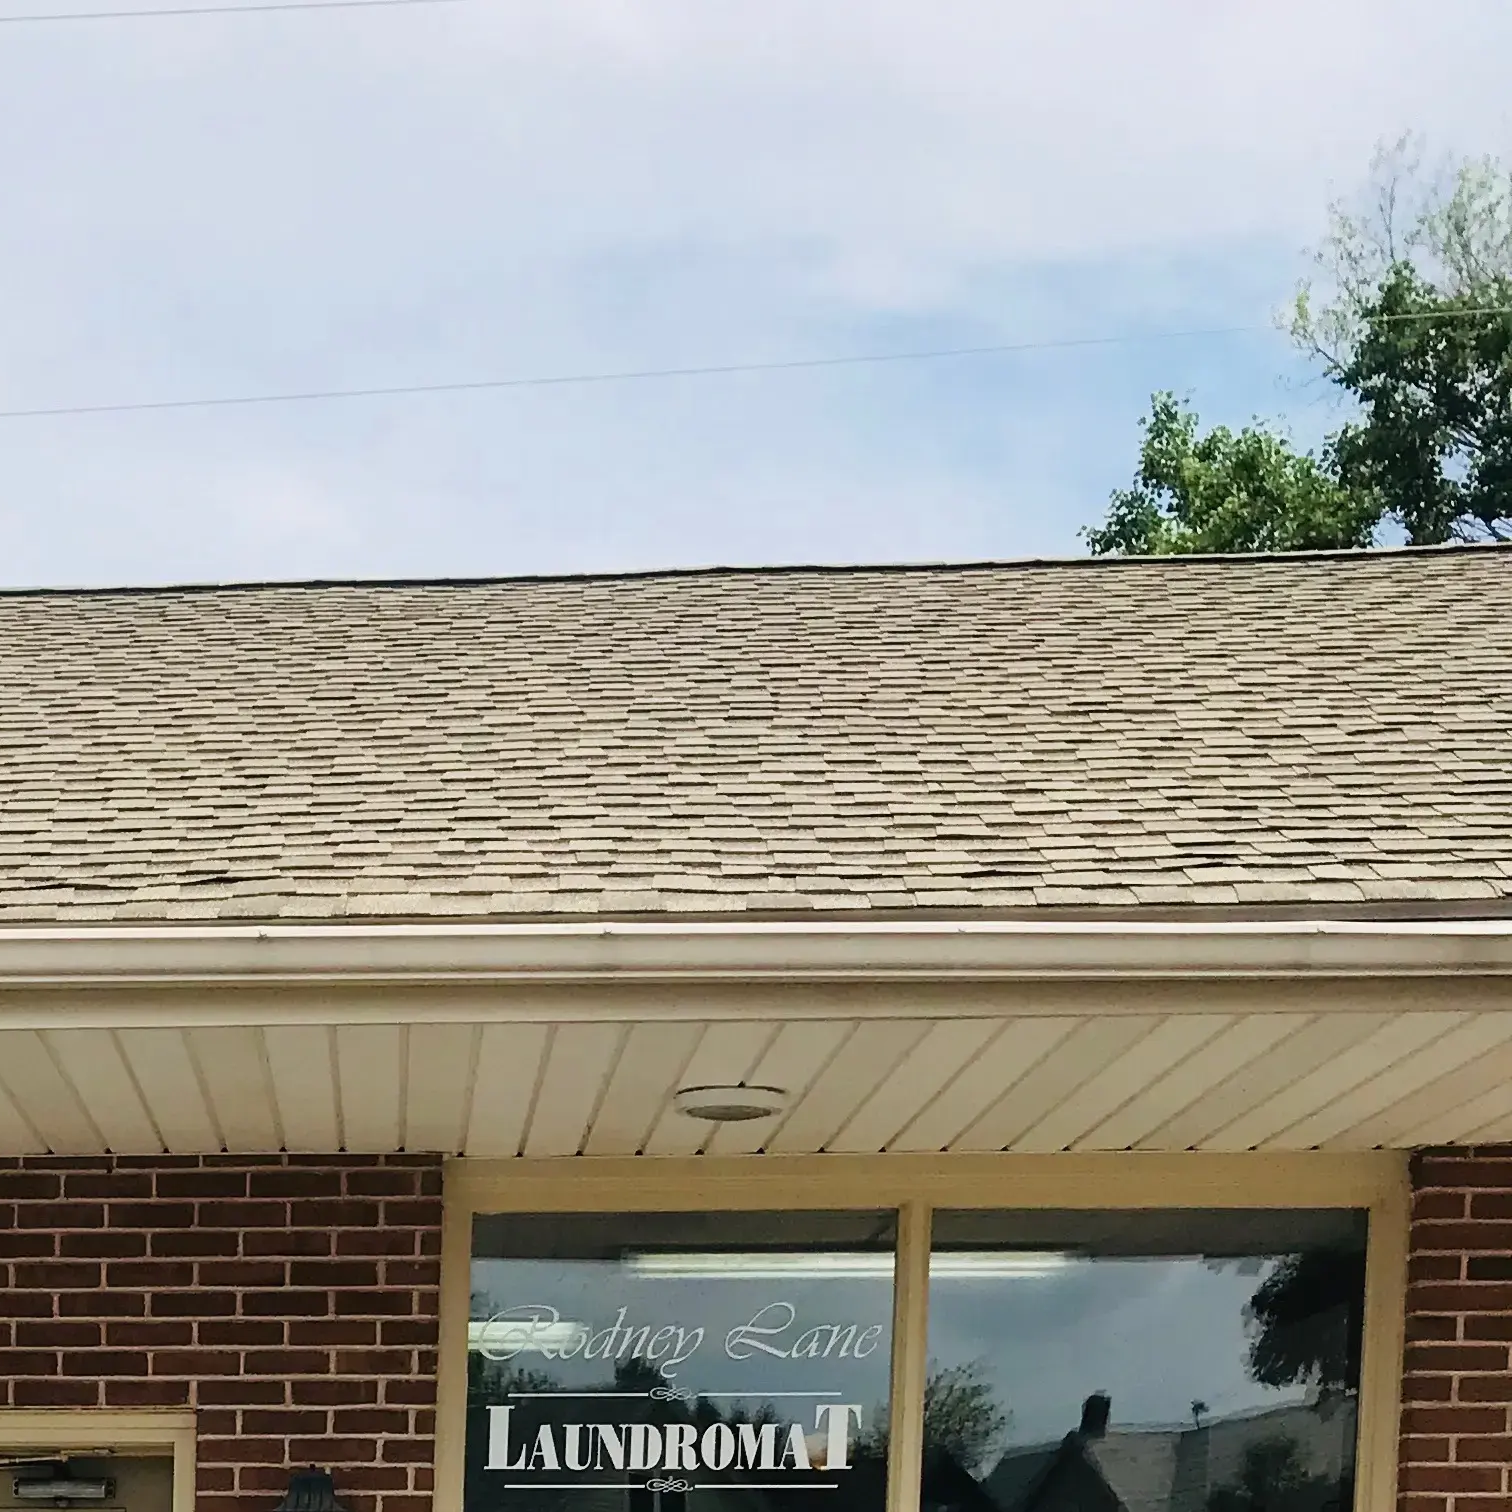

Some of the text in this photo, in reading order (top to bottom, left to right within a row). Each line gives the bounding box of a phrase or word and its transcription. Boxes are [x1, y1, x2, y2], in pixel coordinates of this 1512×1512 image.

[478, 1302, 883, 1378] Rodney Lane
[483, 1404, 862, 1471] LAUNDROMAT
